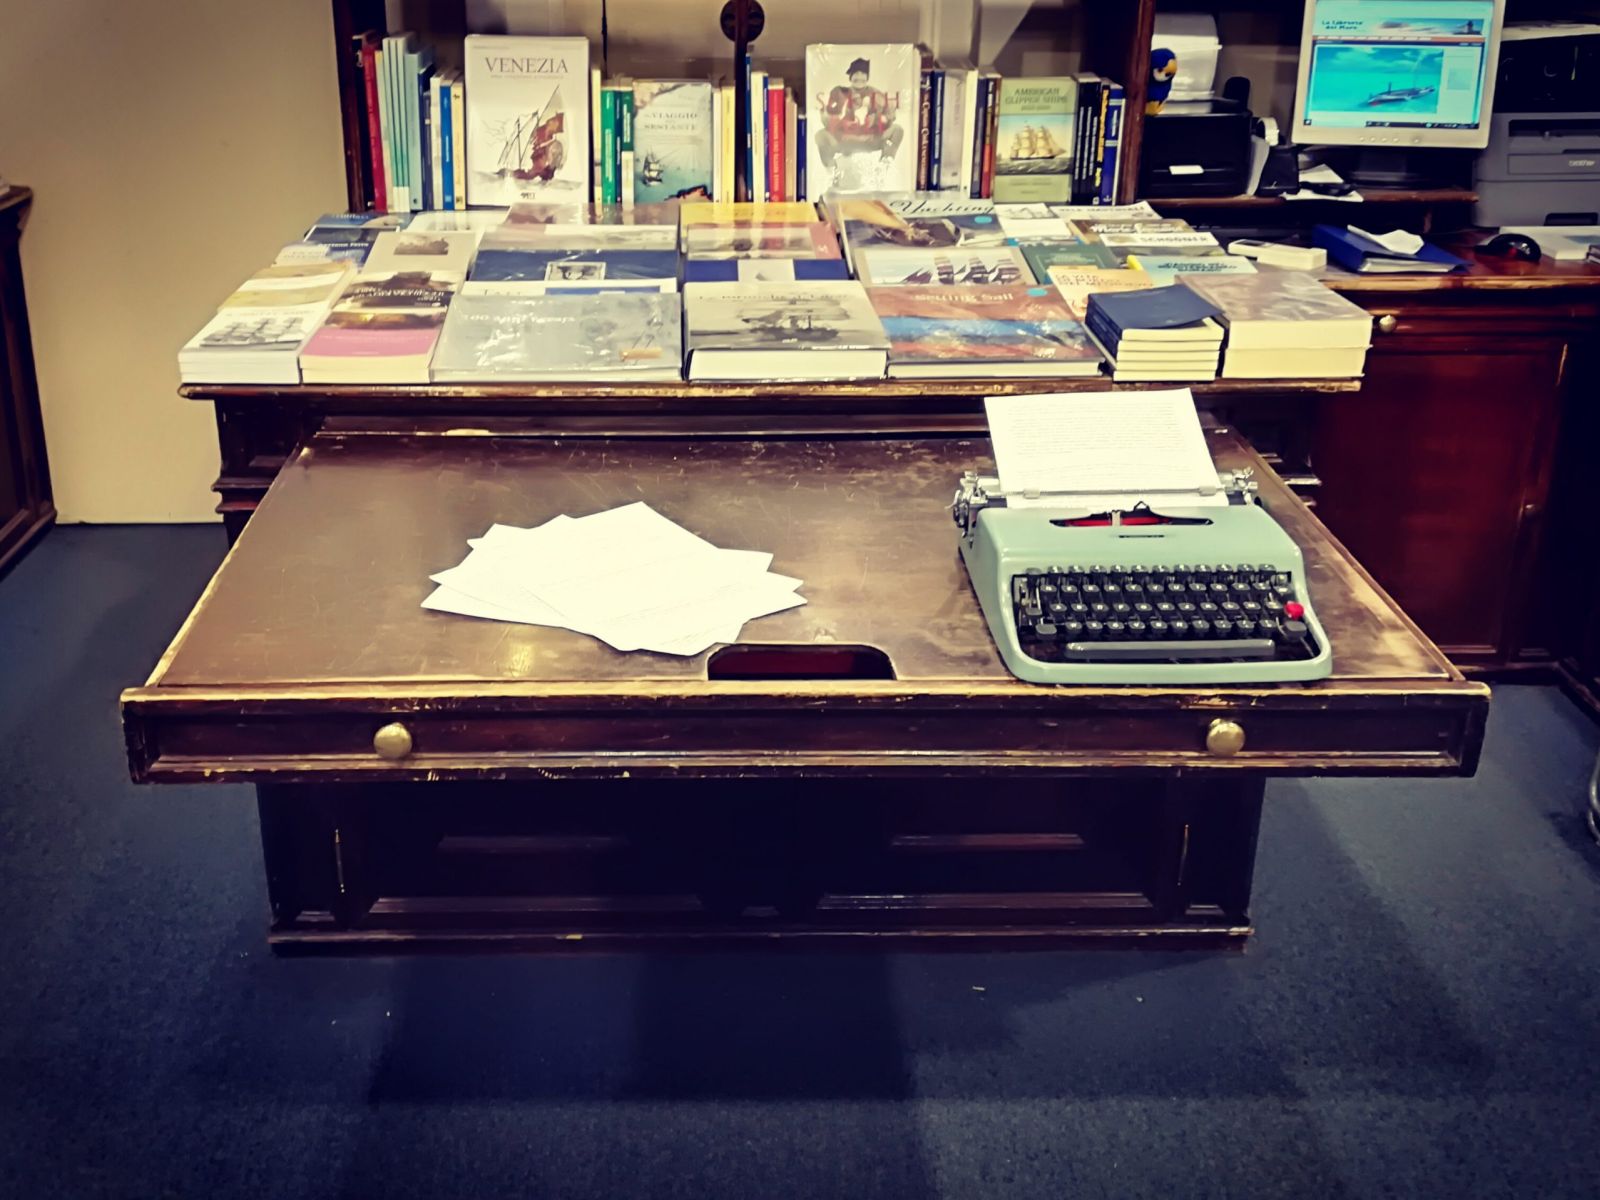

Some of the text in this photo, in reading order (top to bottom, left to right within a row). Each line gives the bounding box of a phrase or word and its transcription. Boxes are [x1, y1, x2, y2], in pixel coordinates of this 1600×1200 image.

[485, 57, 568, 73] VENEZIA
[1014, 87, 1060, 96] AMERICAN
[889, 199, 995, 215] Yachting
